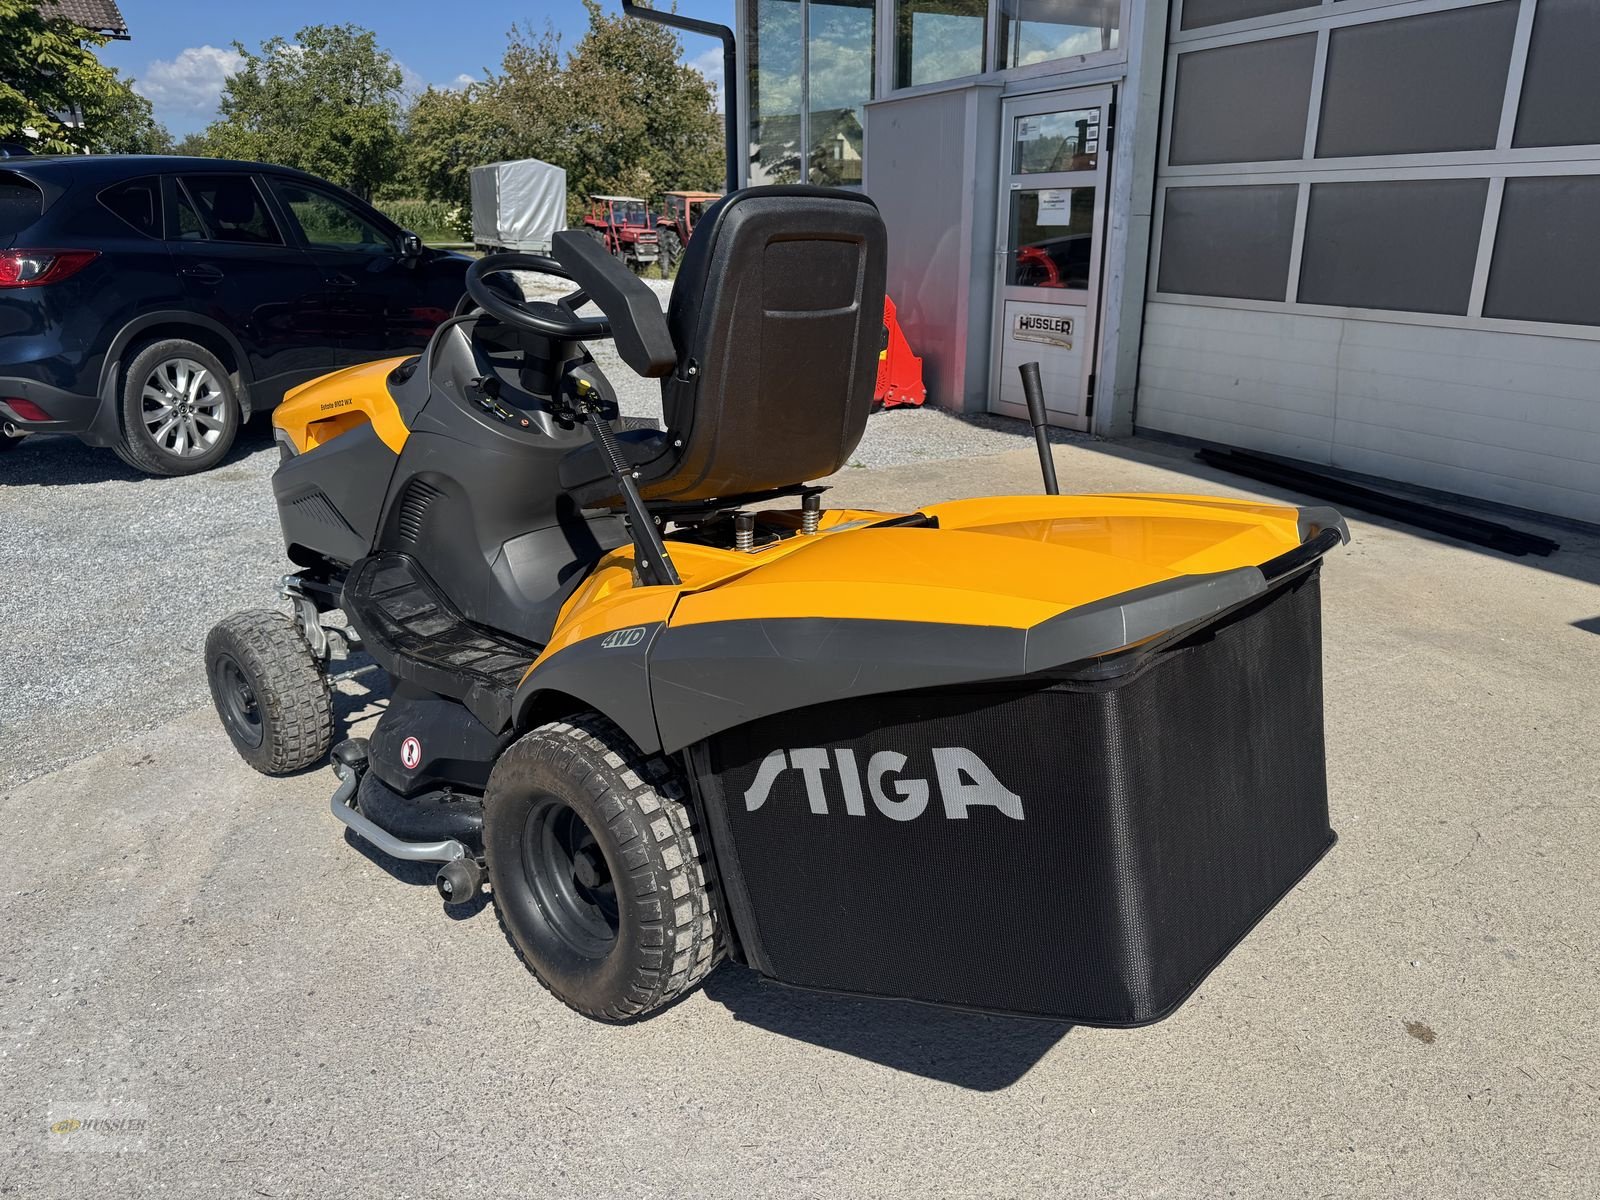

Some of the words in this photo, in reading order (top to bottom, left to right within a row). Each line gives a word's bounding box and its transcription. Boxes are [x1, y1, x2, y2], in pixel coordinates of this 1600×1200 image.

[320, 403, 334, 411] Estate
[601, 627, 646, 649] 4WD
[744, 747, 1025, 821] STIGA
